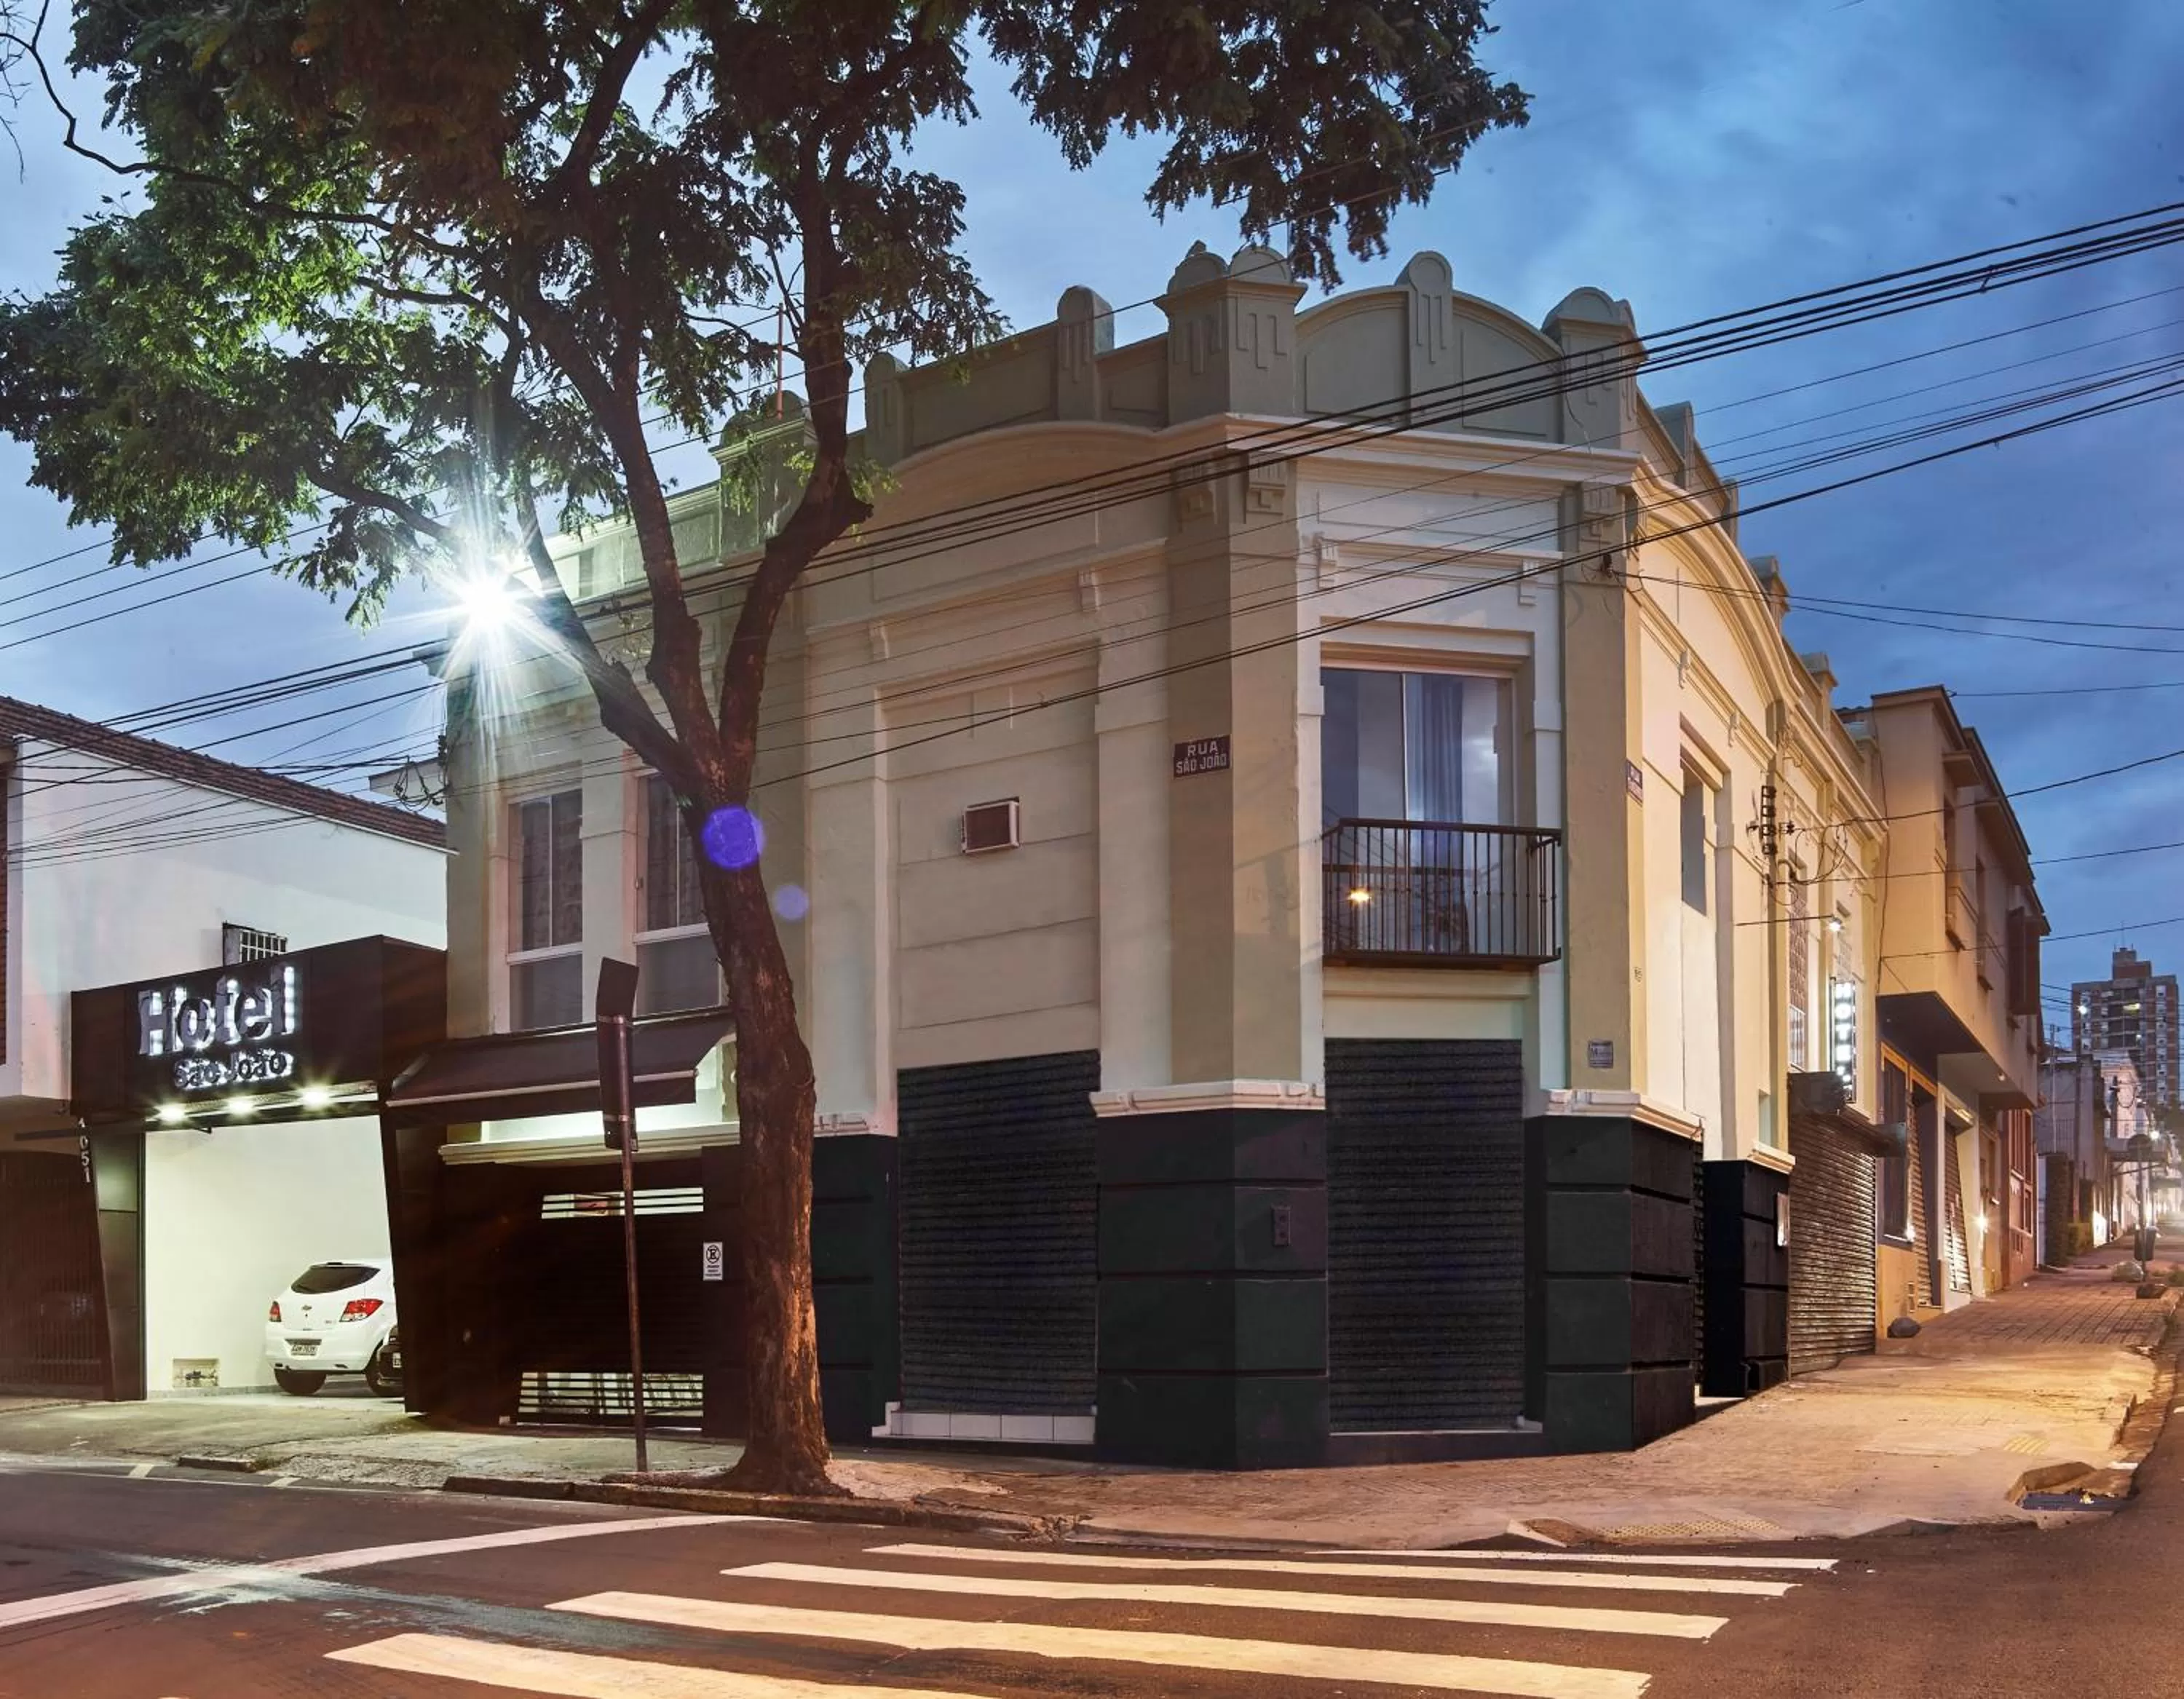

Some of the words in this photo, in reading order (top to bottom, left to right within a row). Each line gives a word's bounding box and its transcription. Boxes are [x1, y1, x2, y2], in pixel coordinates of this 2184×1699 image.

[1188, 741, 1218, 757] RUA
[1176, 757, 1197, 775] SÃO
[1200, 753, 1227, 769] JOÃO
[138, 965, 296, 1056] Hotel
